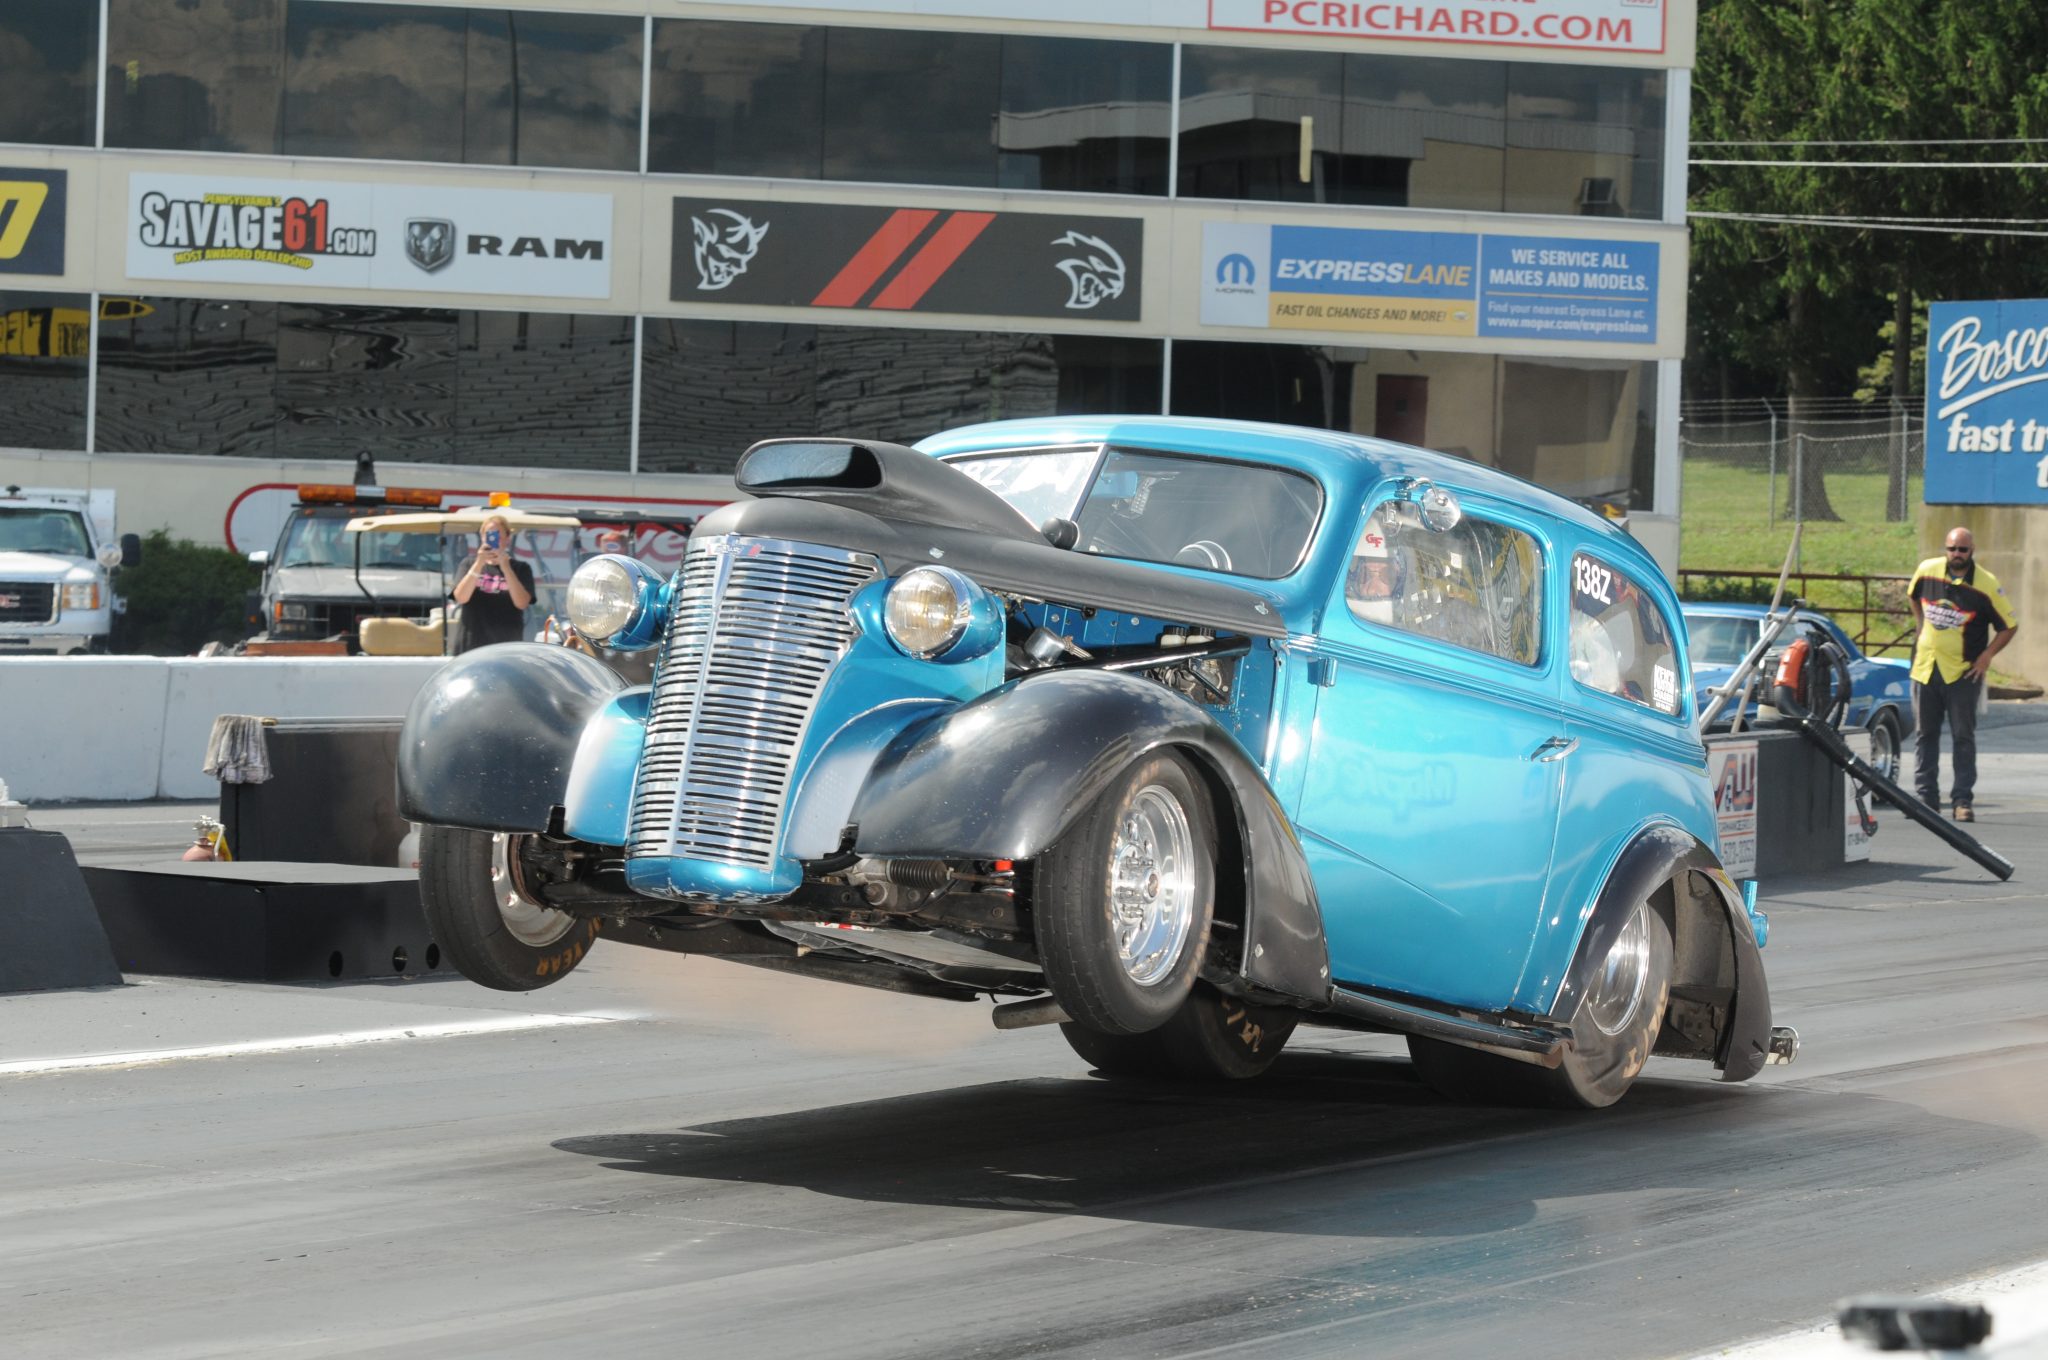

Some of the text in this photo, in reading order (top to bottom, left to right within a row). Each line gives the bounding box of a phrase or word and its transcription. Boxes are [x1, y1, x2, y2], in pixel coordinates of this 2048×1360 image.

[1263, 1, 1633, 43] PCRICHARD.COM
[467, 234, 604, 261] RAM
[1511, 248, 1629, 269] WE SERVICE ALL
[174, 248, 314, 270] MOST AWARDED DEALERSHIP
[1489, 268, 1649, 291] MAKES AND MODELS.
[1276, 303, 1304, 318] FAST
[1306, 305, 1324, 319] OIL
[1326, 306, 1380, 321] CHANGES
[1382, 308, 1407, 321] AND
[1408, 308, 1447, 323] MORE!
[1488, 301, 1508, 313] Find
[1510, 304, 1530, 316] your
[1532, 304, 1569, 316] nearest
[1570, 304, 1607, 319] Express
[1608, 307, 1631, 319] Lane
[1487, 316, 1649, 334] www.mopar.com/expresslane
[1947, 412, 2015, 452] fast
[1574, 557, 1612, 605] 138Z
